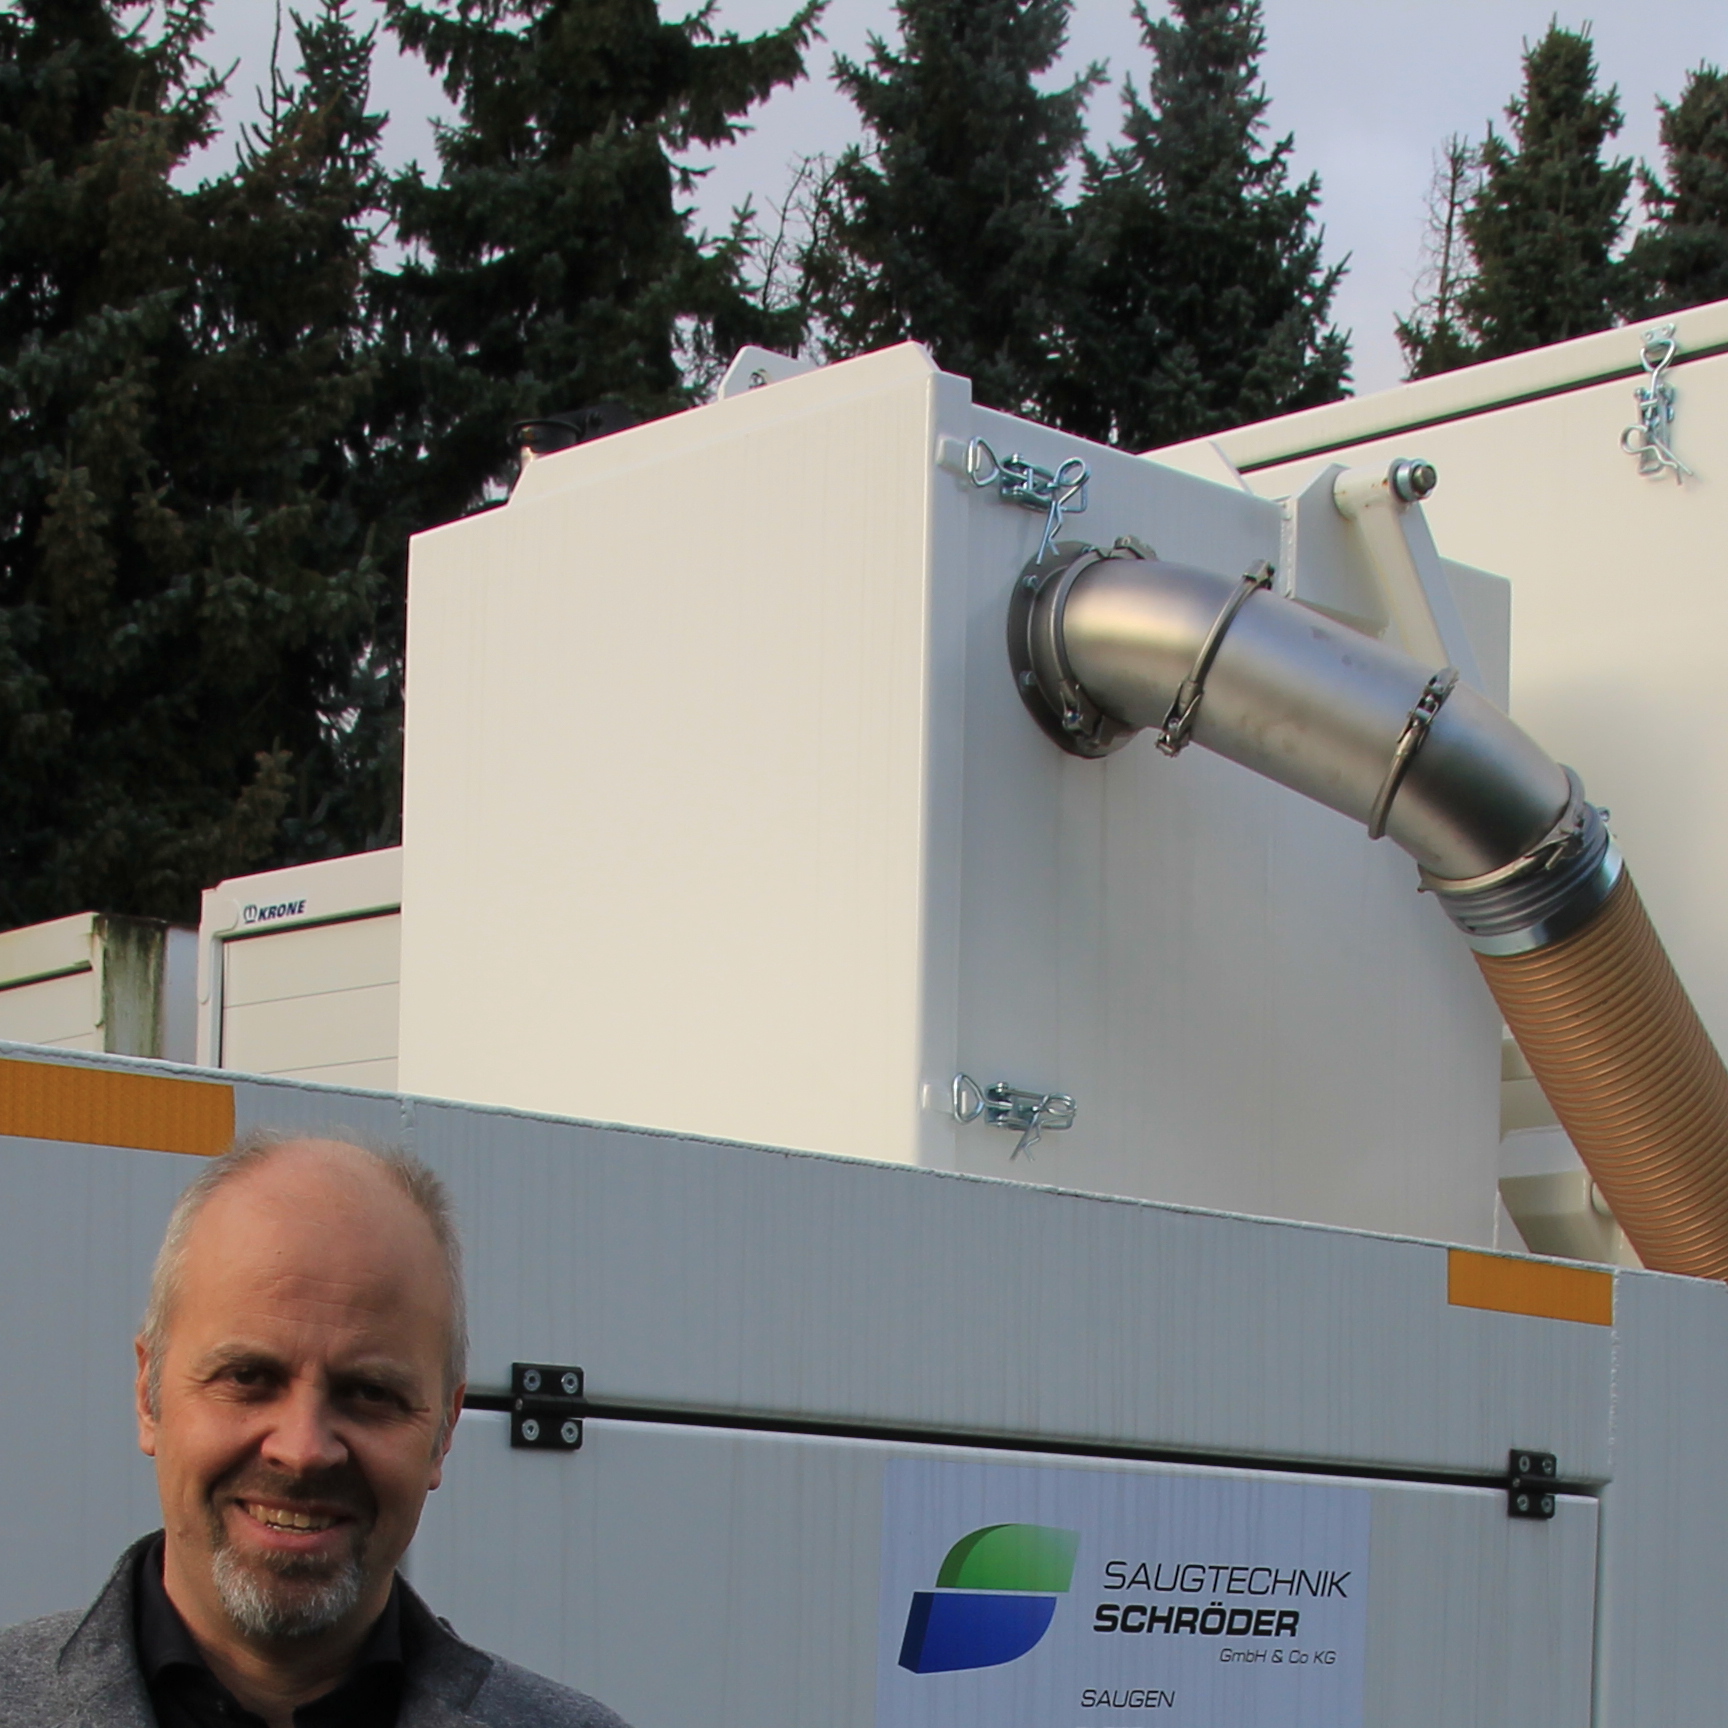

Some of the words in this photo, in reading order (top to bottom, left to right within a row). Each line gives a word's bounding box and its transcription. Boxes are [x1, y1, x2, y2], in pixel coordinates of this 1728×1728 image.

[258, 900, 306, 921] KRONE
[1103, 1561, 1352, 1598] SAUGTECHNIK
[1093, 1601, 1300, 1637] SCHRÖDER
[1220, 1648, 1267, 1663] GmbH
[1272, 1650, 1283, 1663] &
[1289, 1650, 1308, 1663] Co
[1313, 1651, 1336, 1664] KG
[1081, 1689, 1175, 1708] SAUGEN
